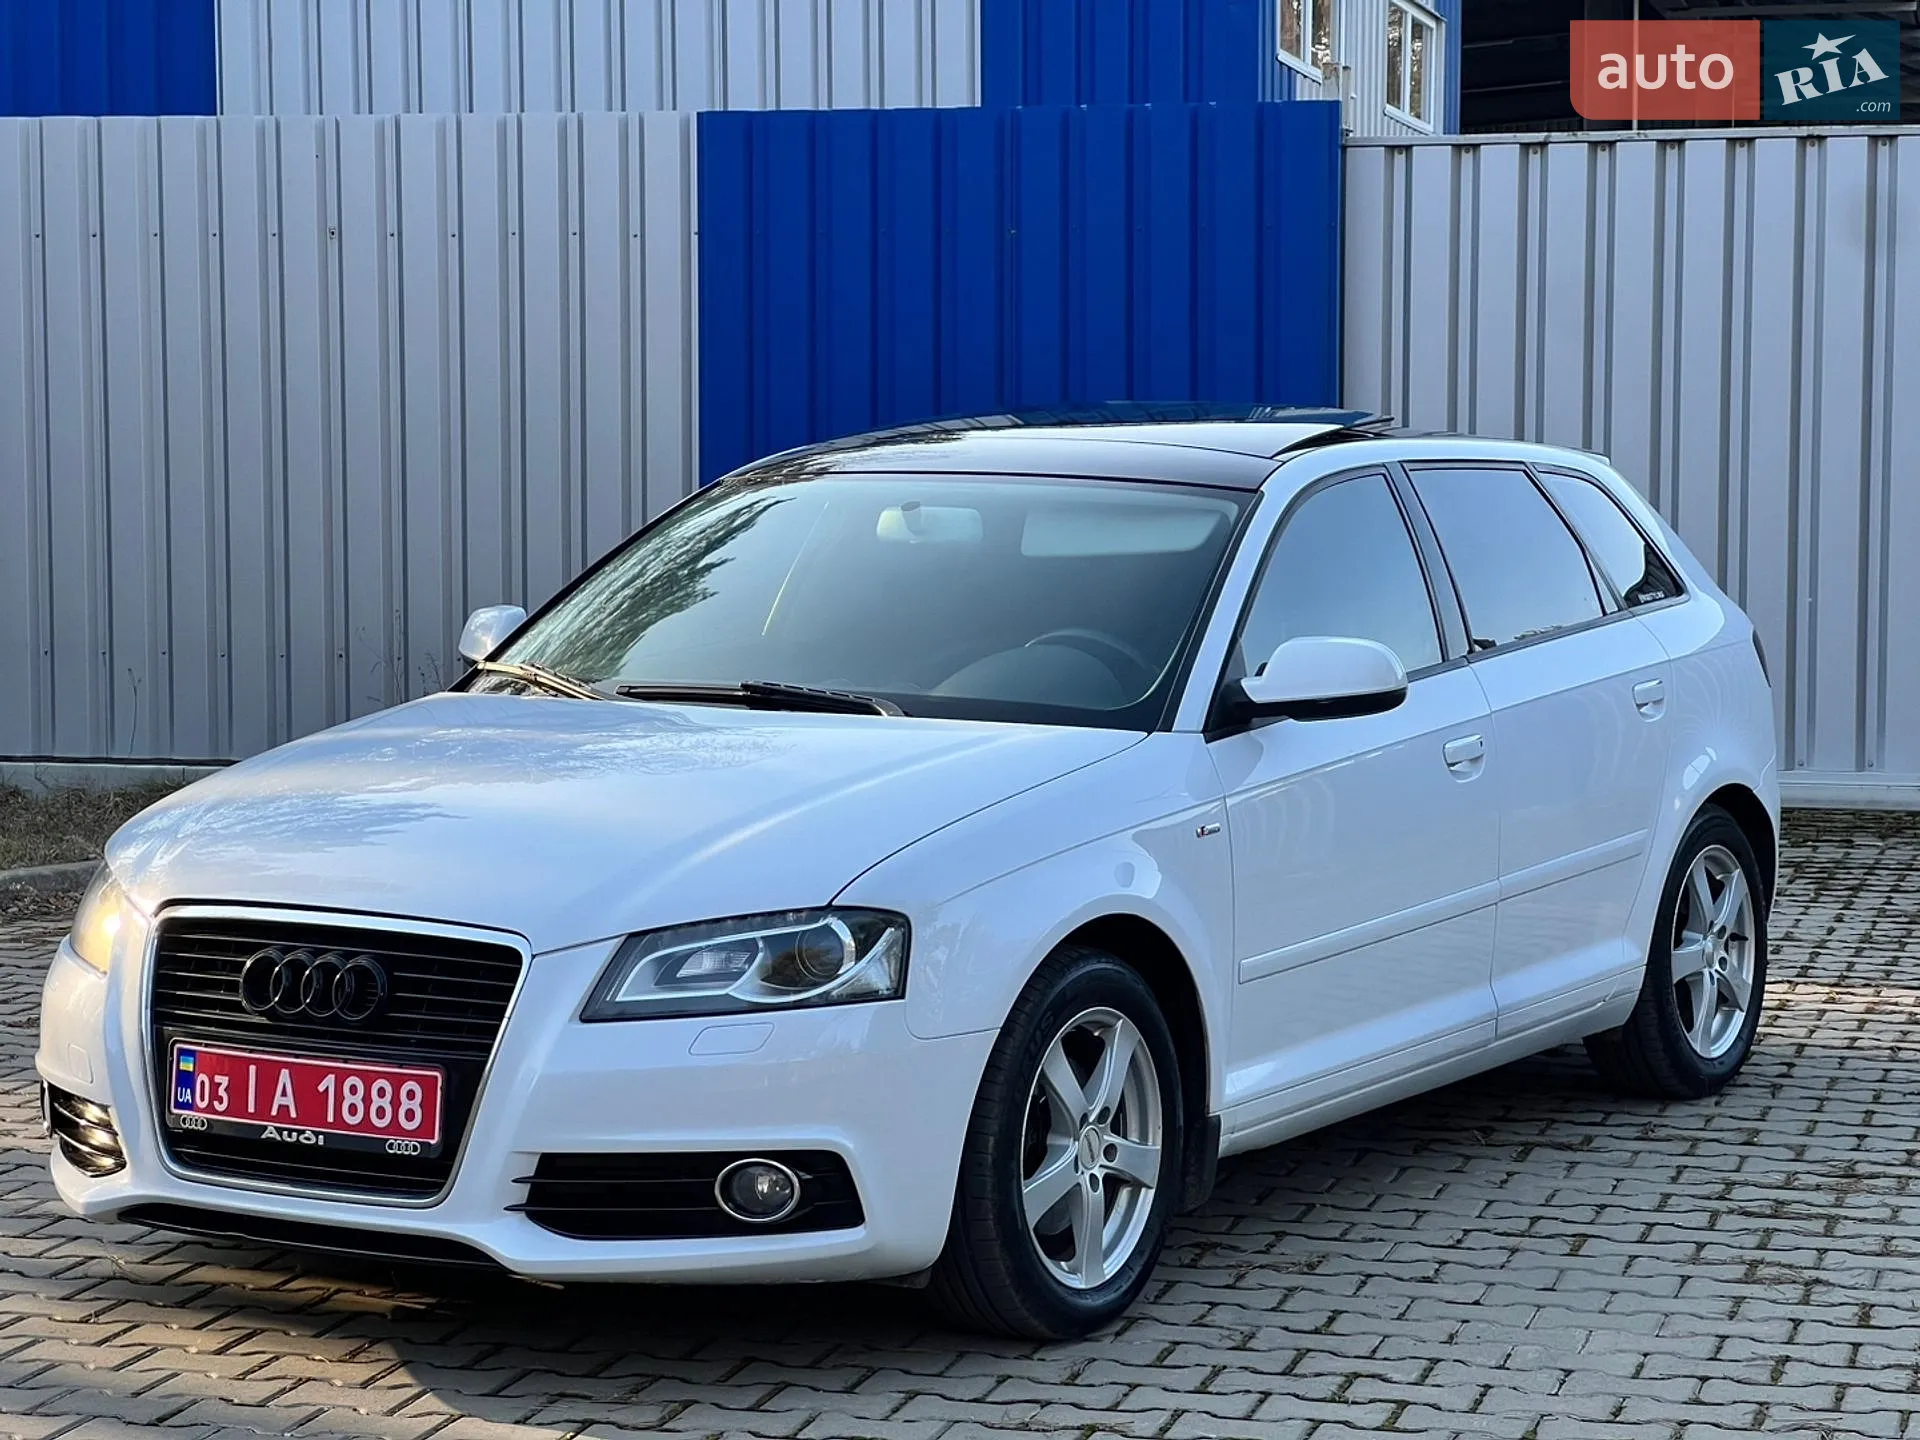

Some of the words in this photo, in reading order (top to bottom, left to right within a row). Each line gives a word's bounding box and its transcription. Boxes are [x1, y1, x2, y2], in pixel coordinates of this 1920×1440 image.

[177, 1086, 192, 1103] UA
[195, 1073, 230, 1112] 03
[317, 1073, 423, 1131] 1888
[260, 1126, 325, 1146] Audi
